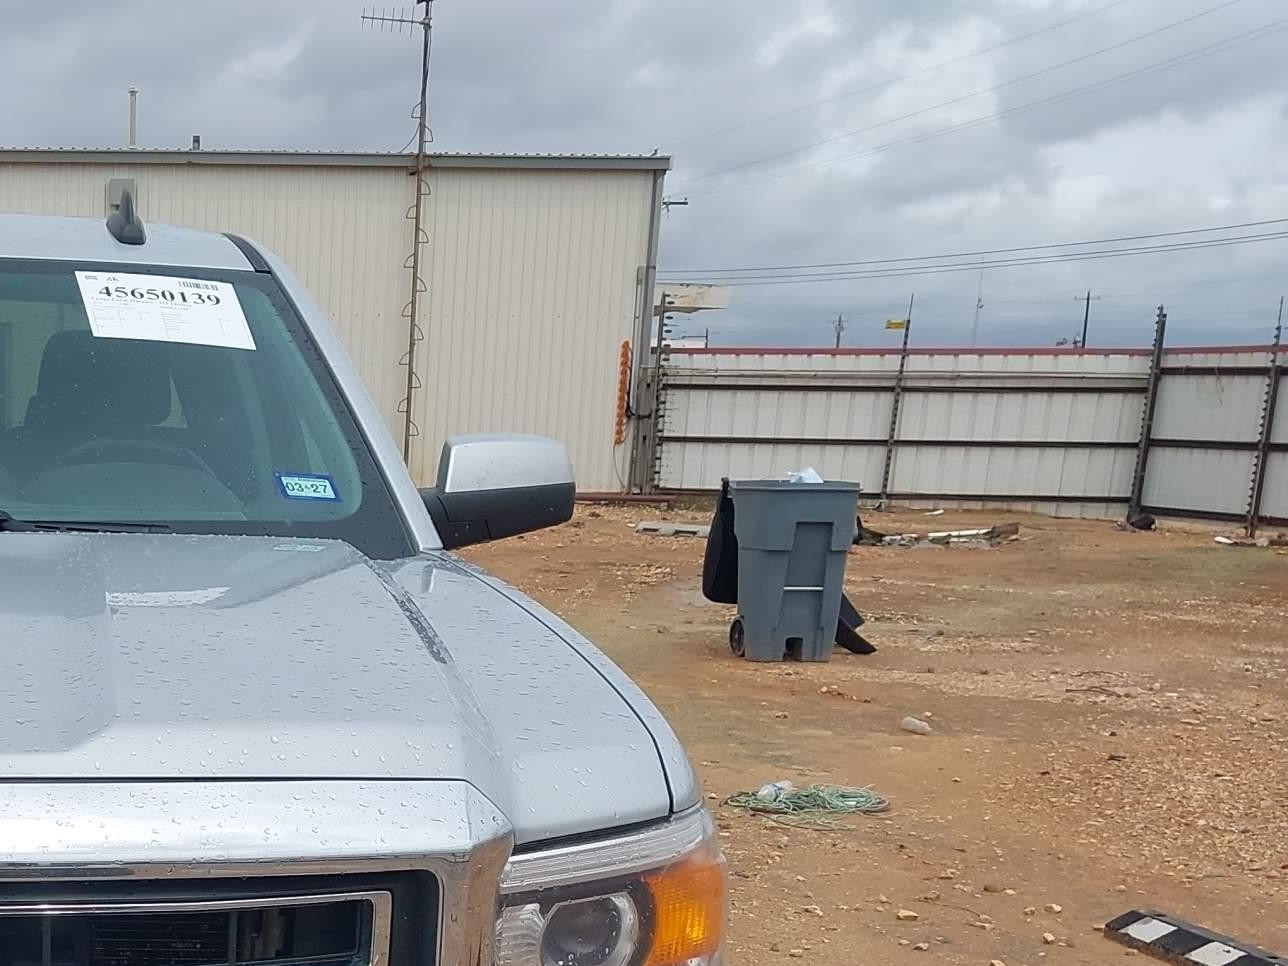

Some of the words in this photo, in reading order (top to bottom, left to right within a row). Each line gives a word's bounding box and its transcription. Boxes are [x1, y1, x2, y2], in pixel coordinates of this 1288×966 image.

[98, 286, 221, 306] 45650139
[285, 482, 305, 493] 03
[310, 483, 328, 494] 27
